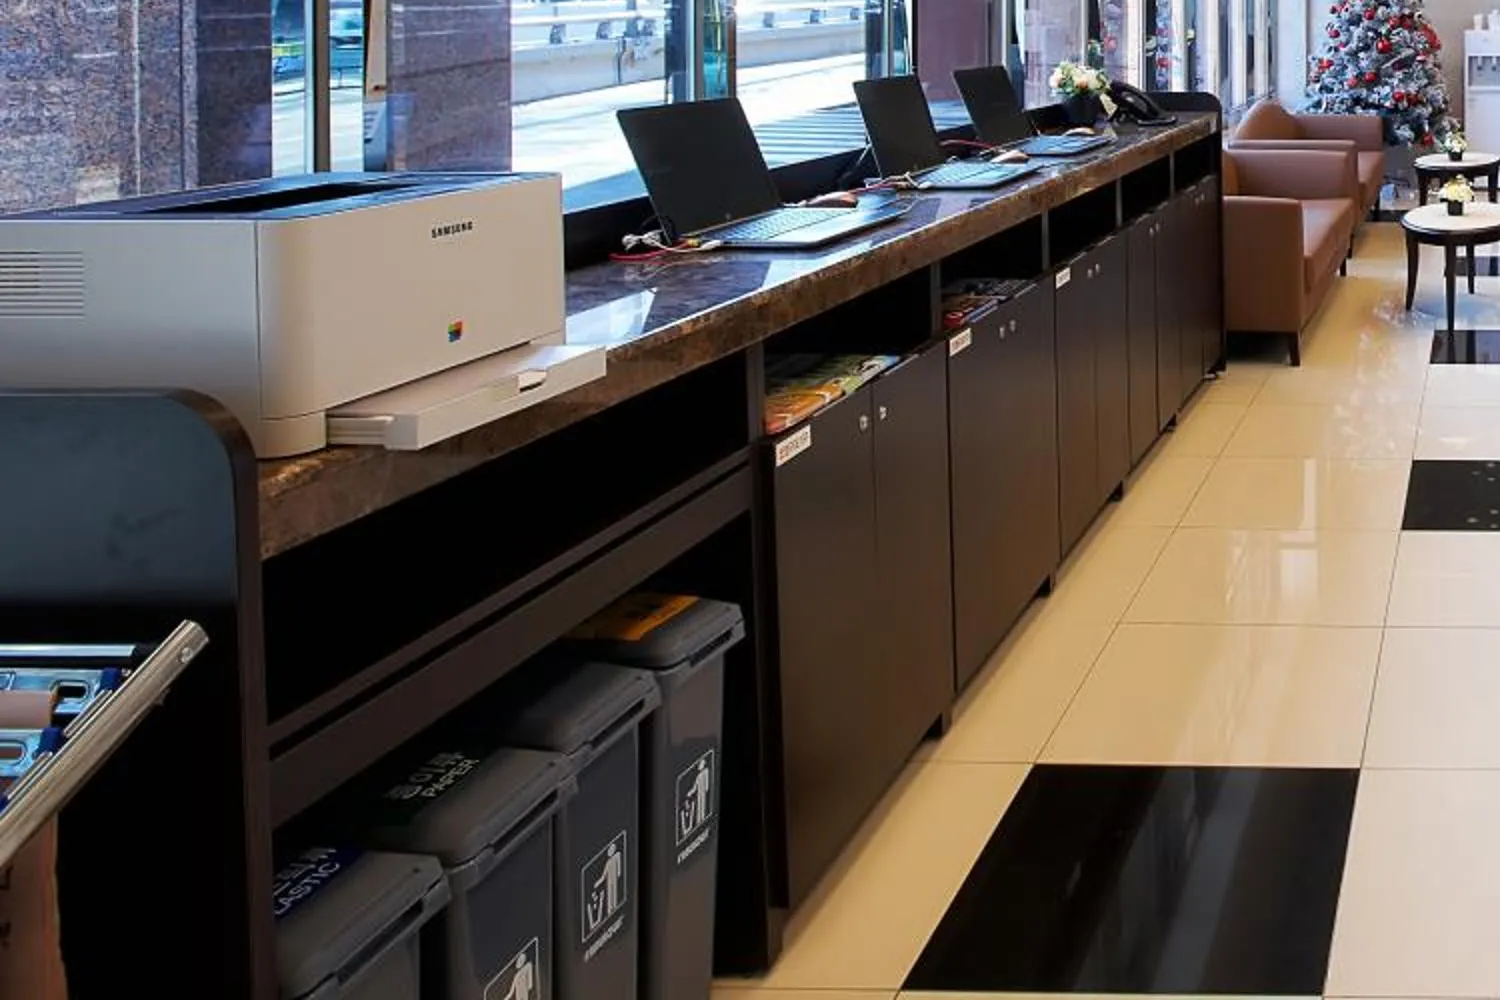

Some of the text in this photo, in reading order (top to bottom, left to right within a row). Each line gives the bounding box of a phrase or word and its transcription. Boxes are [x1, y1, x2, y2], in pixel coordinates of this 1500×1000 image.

[431, 221, 473, 239] SAMSUNG
[420, 759, 480, 798] PAPER
[274, 862, 341, 915] LASTIC
